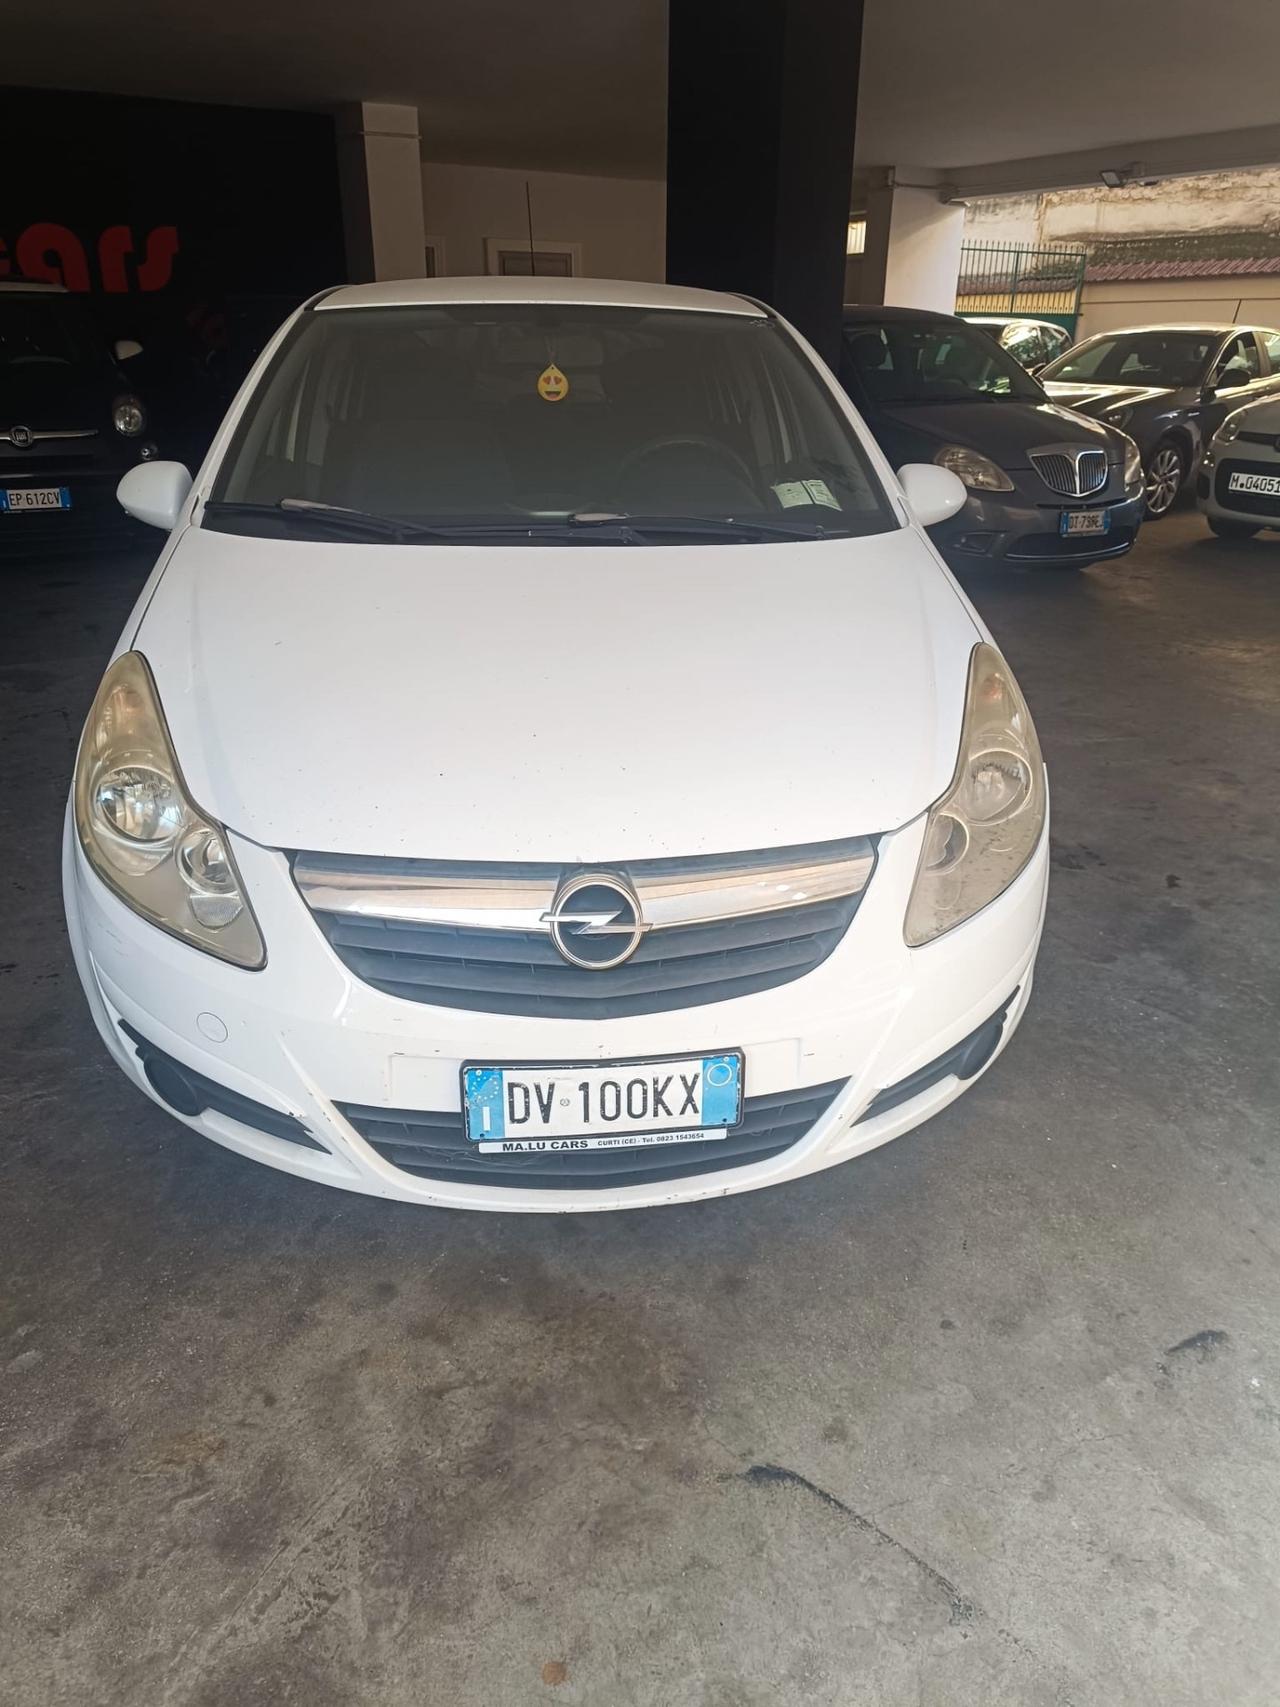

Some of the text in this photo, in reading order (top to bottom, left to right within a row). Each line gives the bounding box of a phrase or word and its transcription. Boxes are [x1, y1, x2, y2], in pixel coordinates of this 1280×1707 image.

[0, 221, 179, 292] ars
[9, 491, 60, 506] EP 612CV
[507, 1081, 555, 1125] DV
[578, 1072, 701, 1123] 100KX
[502, 1141, 548, 1152] MA.LU
[550, 1139, 589, 1150] CARS
[597, 1139, 620, 1147] CURTI
[621, 1138, 637, 1146] (CE)
[642, 1136, 655, 1144] Tel.
